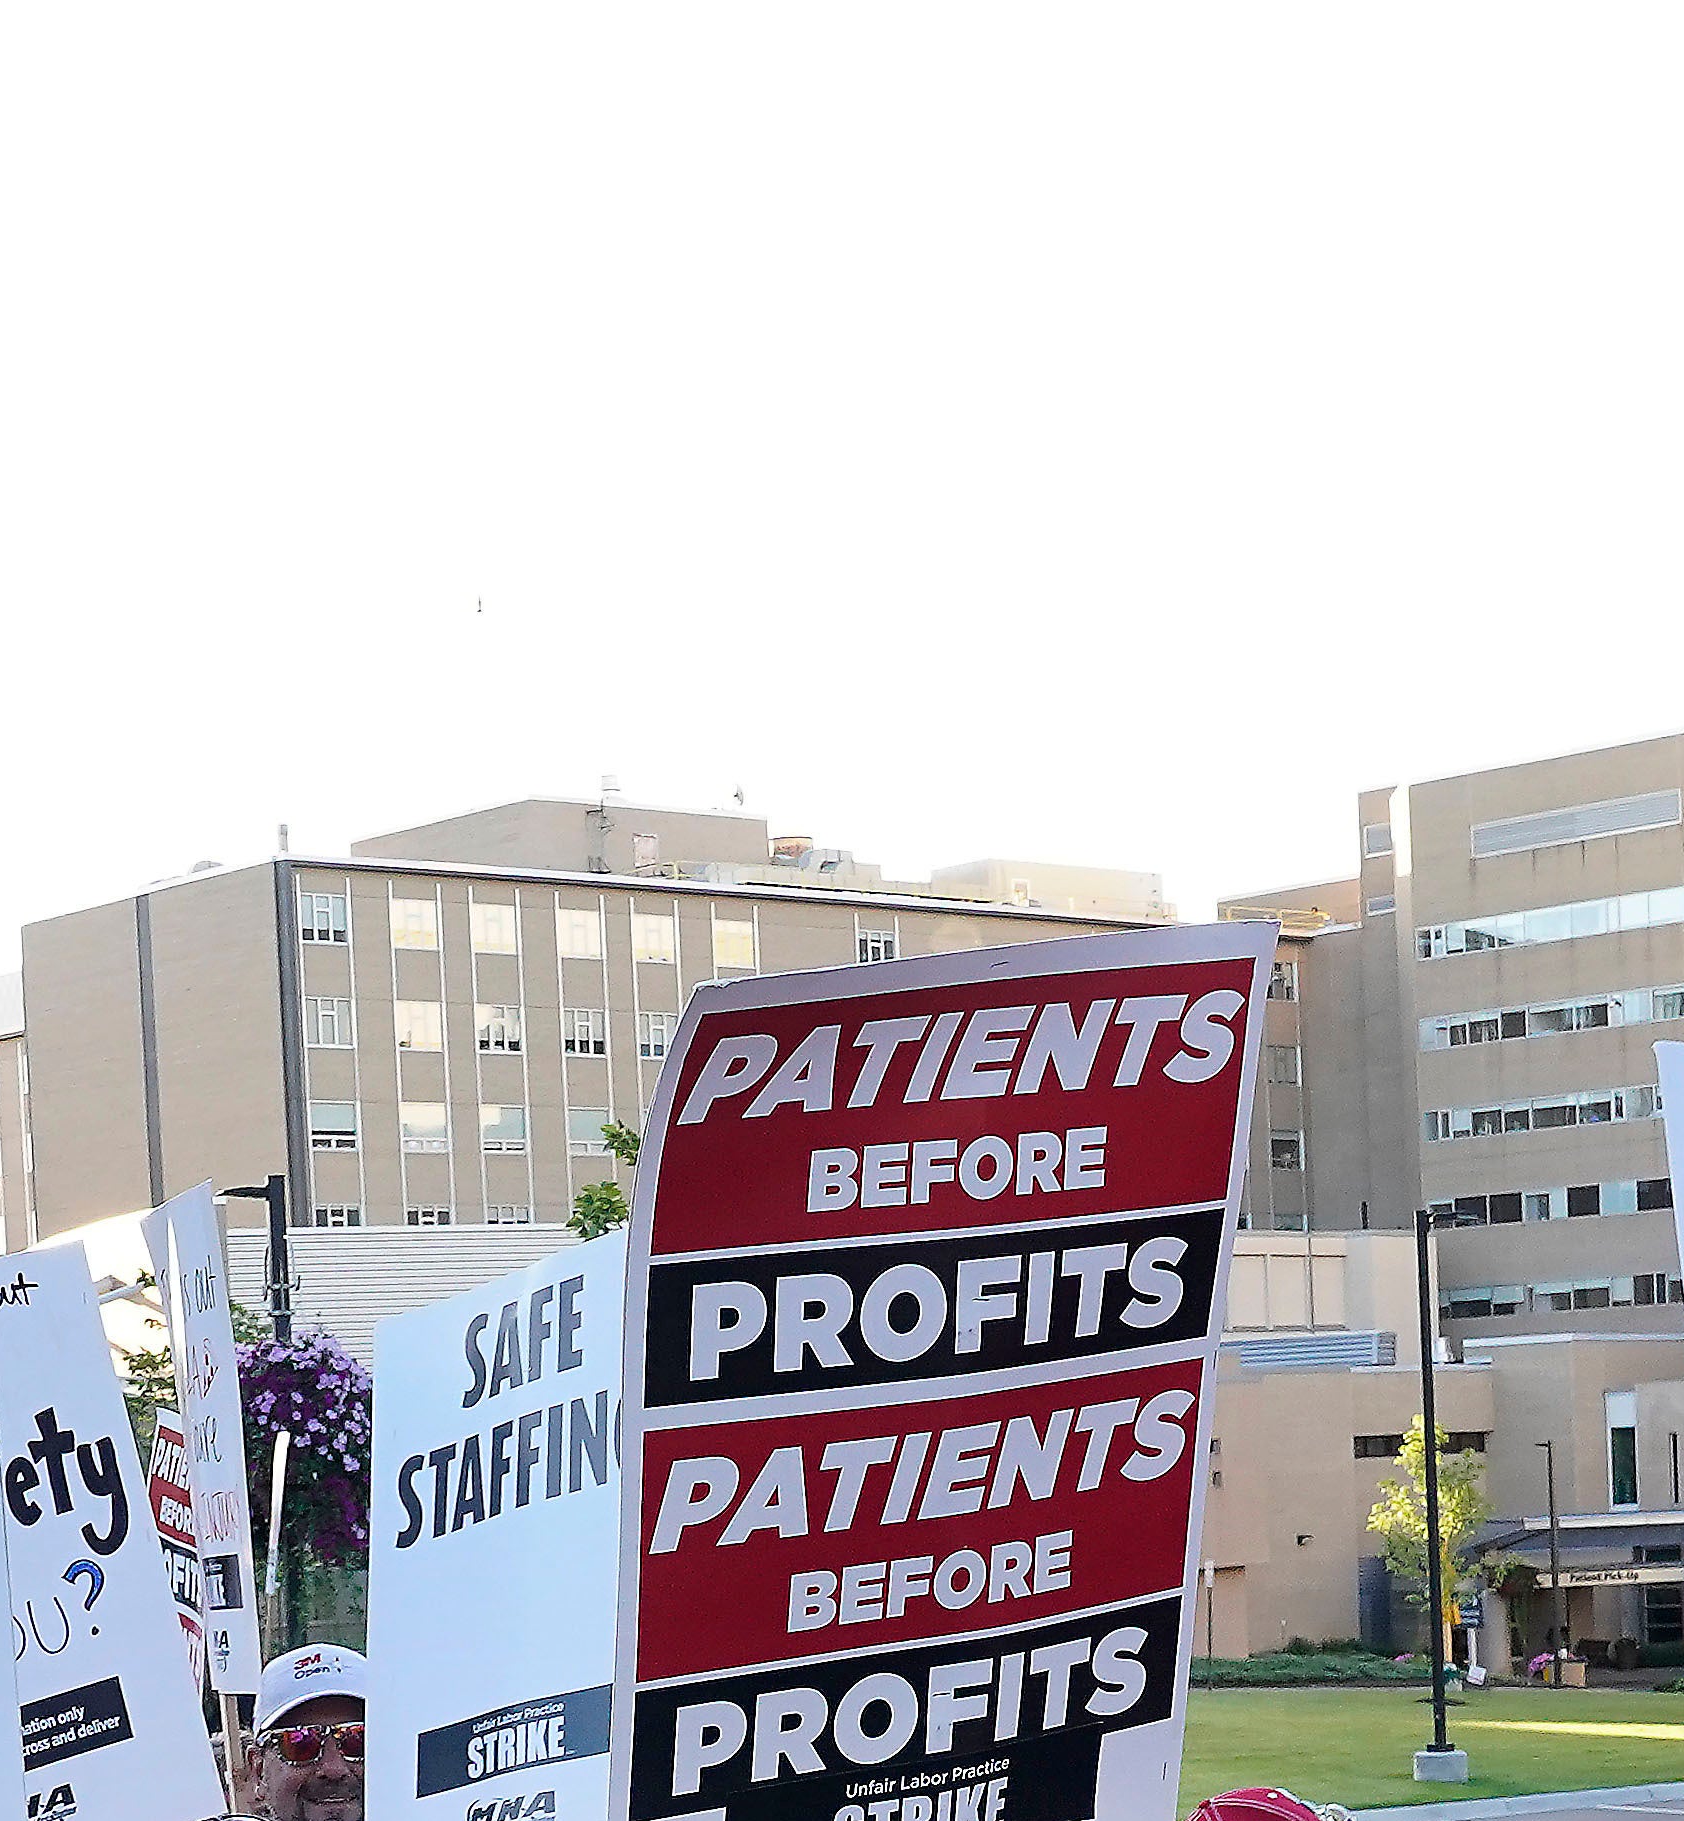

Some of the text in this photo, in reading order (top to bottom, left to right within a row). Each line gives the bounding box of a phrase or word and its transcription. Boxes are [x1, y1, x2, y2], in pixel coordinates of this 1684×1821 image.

[675, 986, 1245, 1128] PATIENTS
[805, 1124, 1108, 1214] BEFORE
[462, 1274, 584, 1408] SAFE
[687, 1235, 1191, 1382] PROFITS
[5, 1406, 129, 1557] ety
[396, 1390, 622, 1549] STAFFIN
[648, 1388, 1195, 1556] PATIENTS
[785, 1529, 1075, 1635] BEFORE
[22, 1706, 85, 1737] ation only
[51, 1729, 77, 1747] and
[77, 1715, 121, 1739] deliver
[467, 1715, 566, 1779] STRIKE
[524, 1701, 565, 1720] Practice
[670, 1625, 1149, 1798] PROFITS
[846, 1758, 1010, 1798] Unfair Labor Practice
